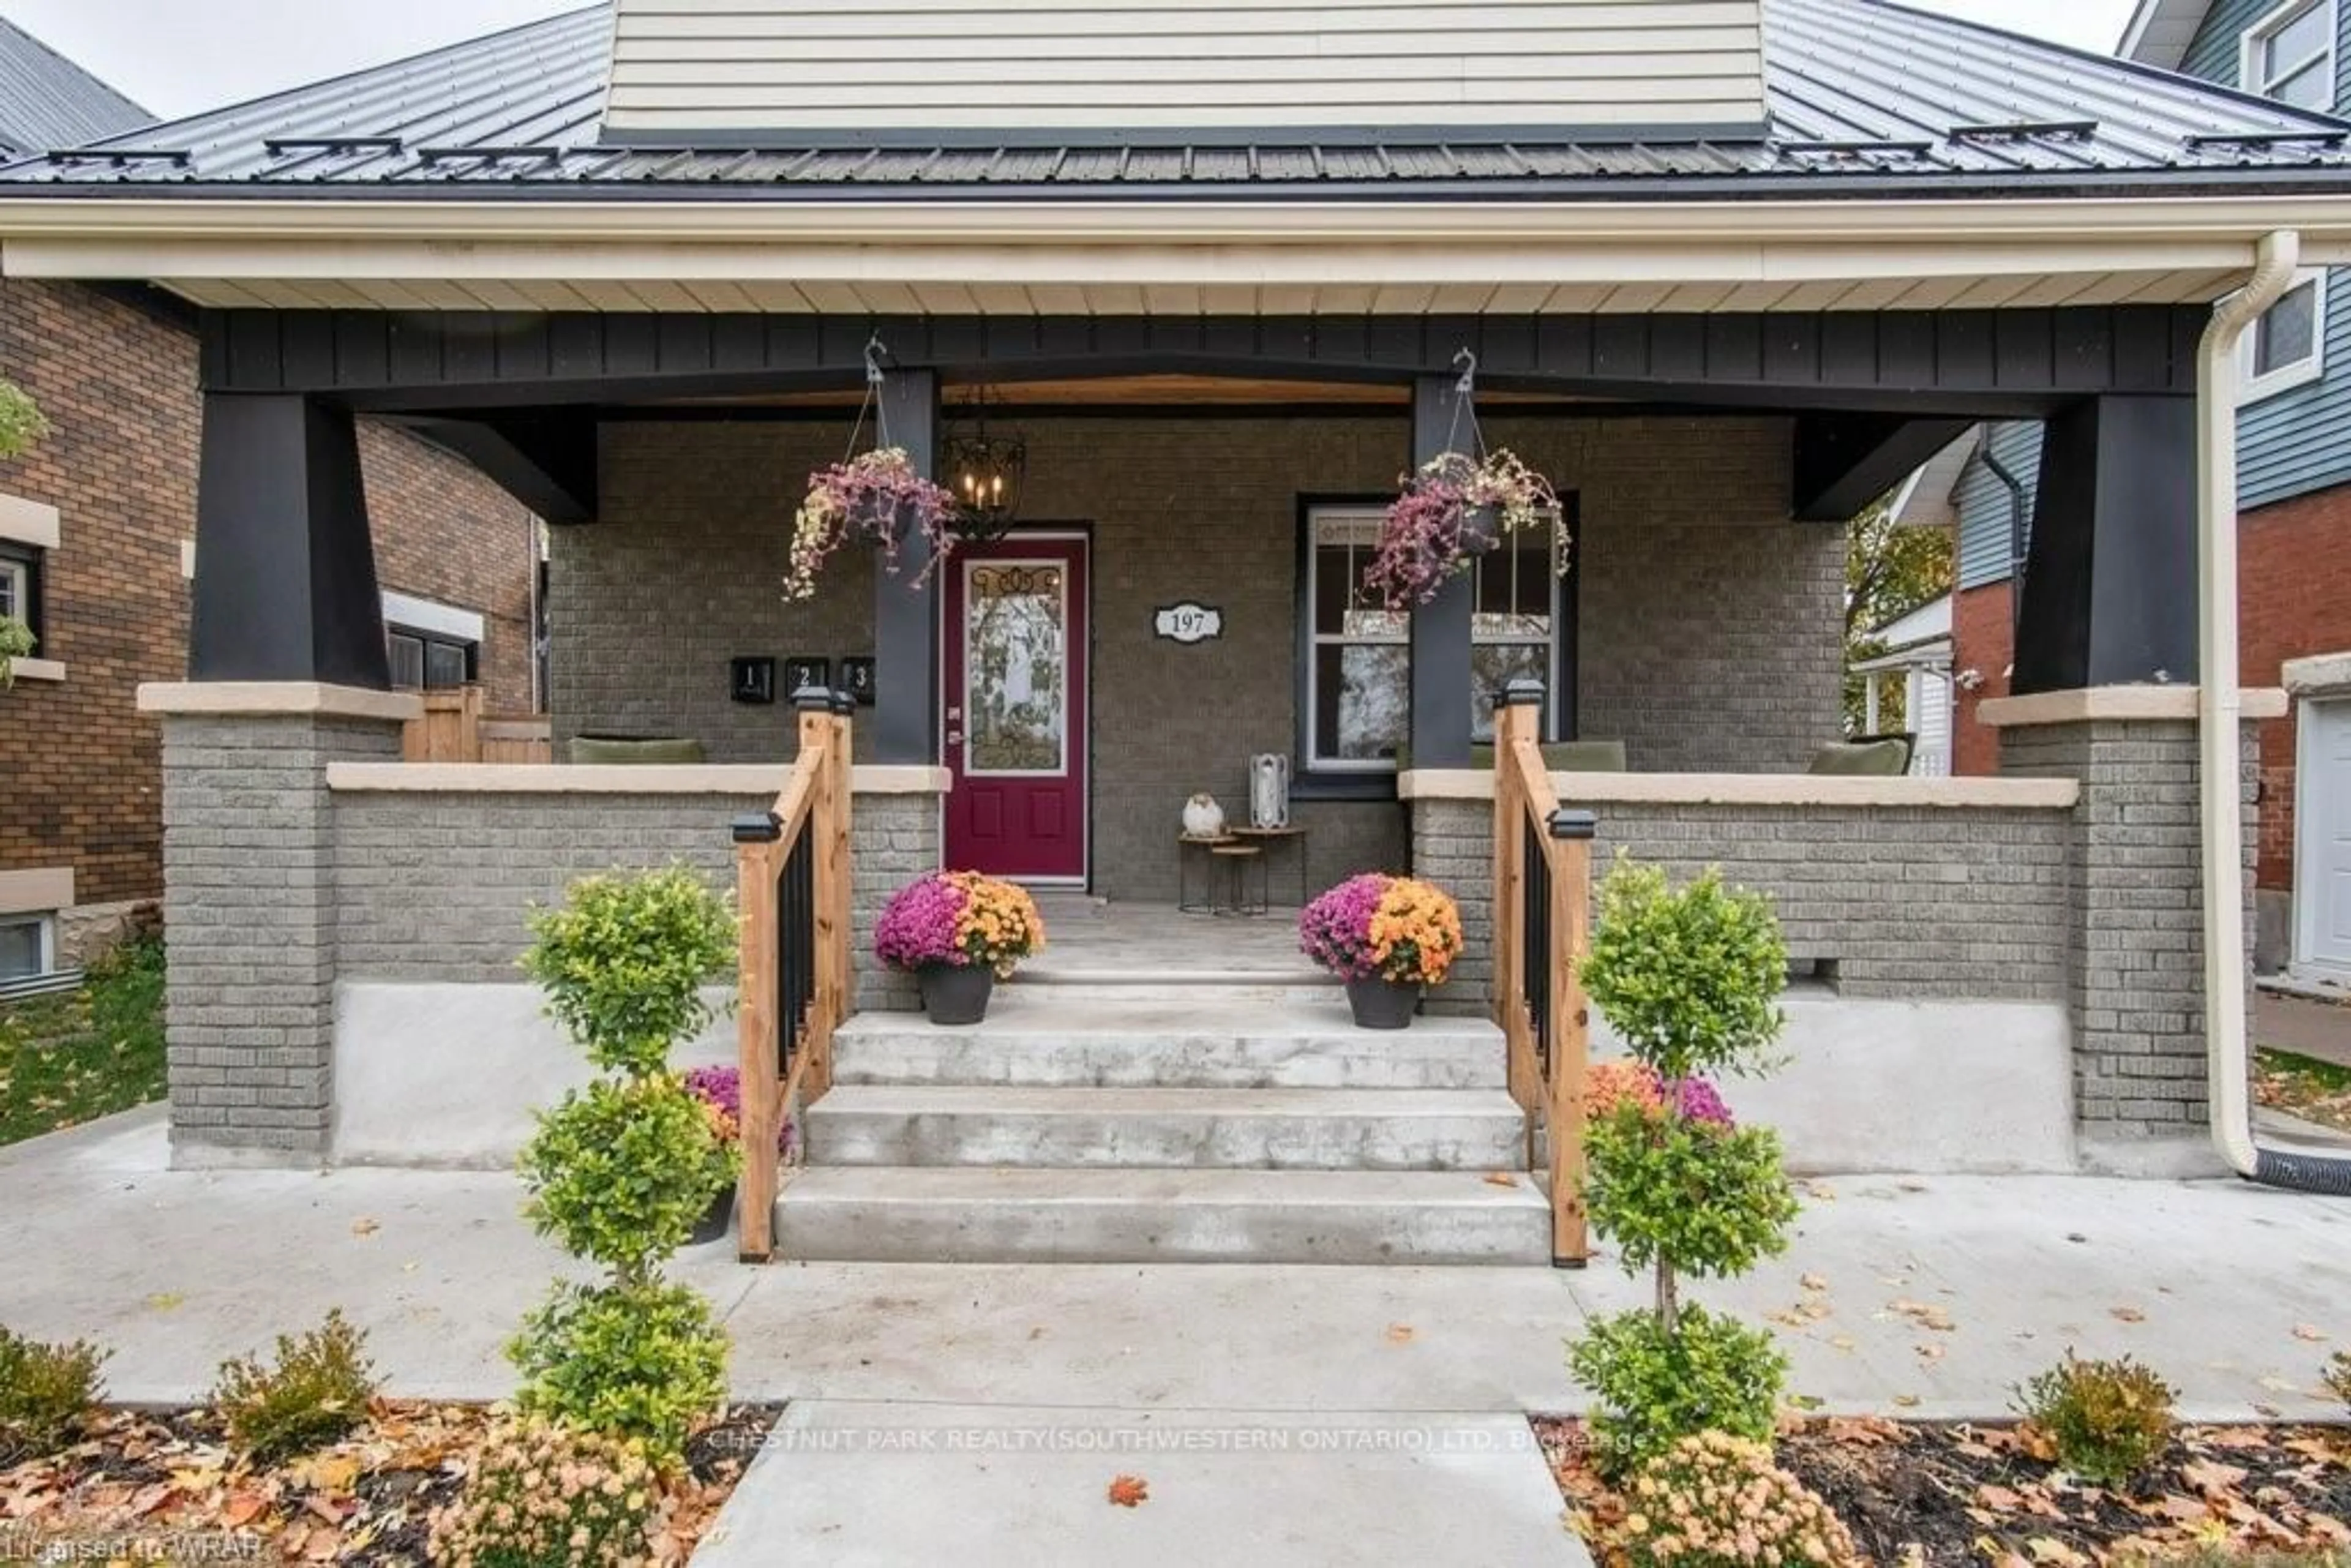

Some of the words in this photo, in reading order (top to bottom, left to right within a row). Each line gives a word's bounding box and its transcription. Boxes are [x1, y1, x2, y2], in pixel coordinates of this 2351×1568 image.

[1171, 612, 1204, 632] 197
[747, 665, 753, 685] 1
[800, 667, 809, 686] 2
[856, 667, 866, 686] 3
